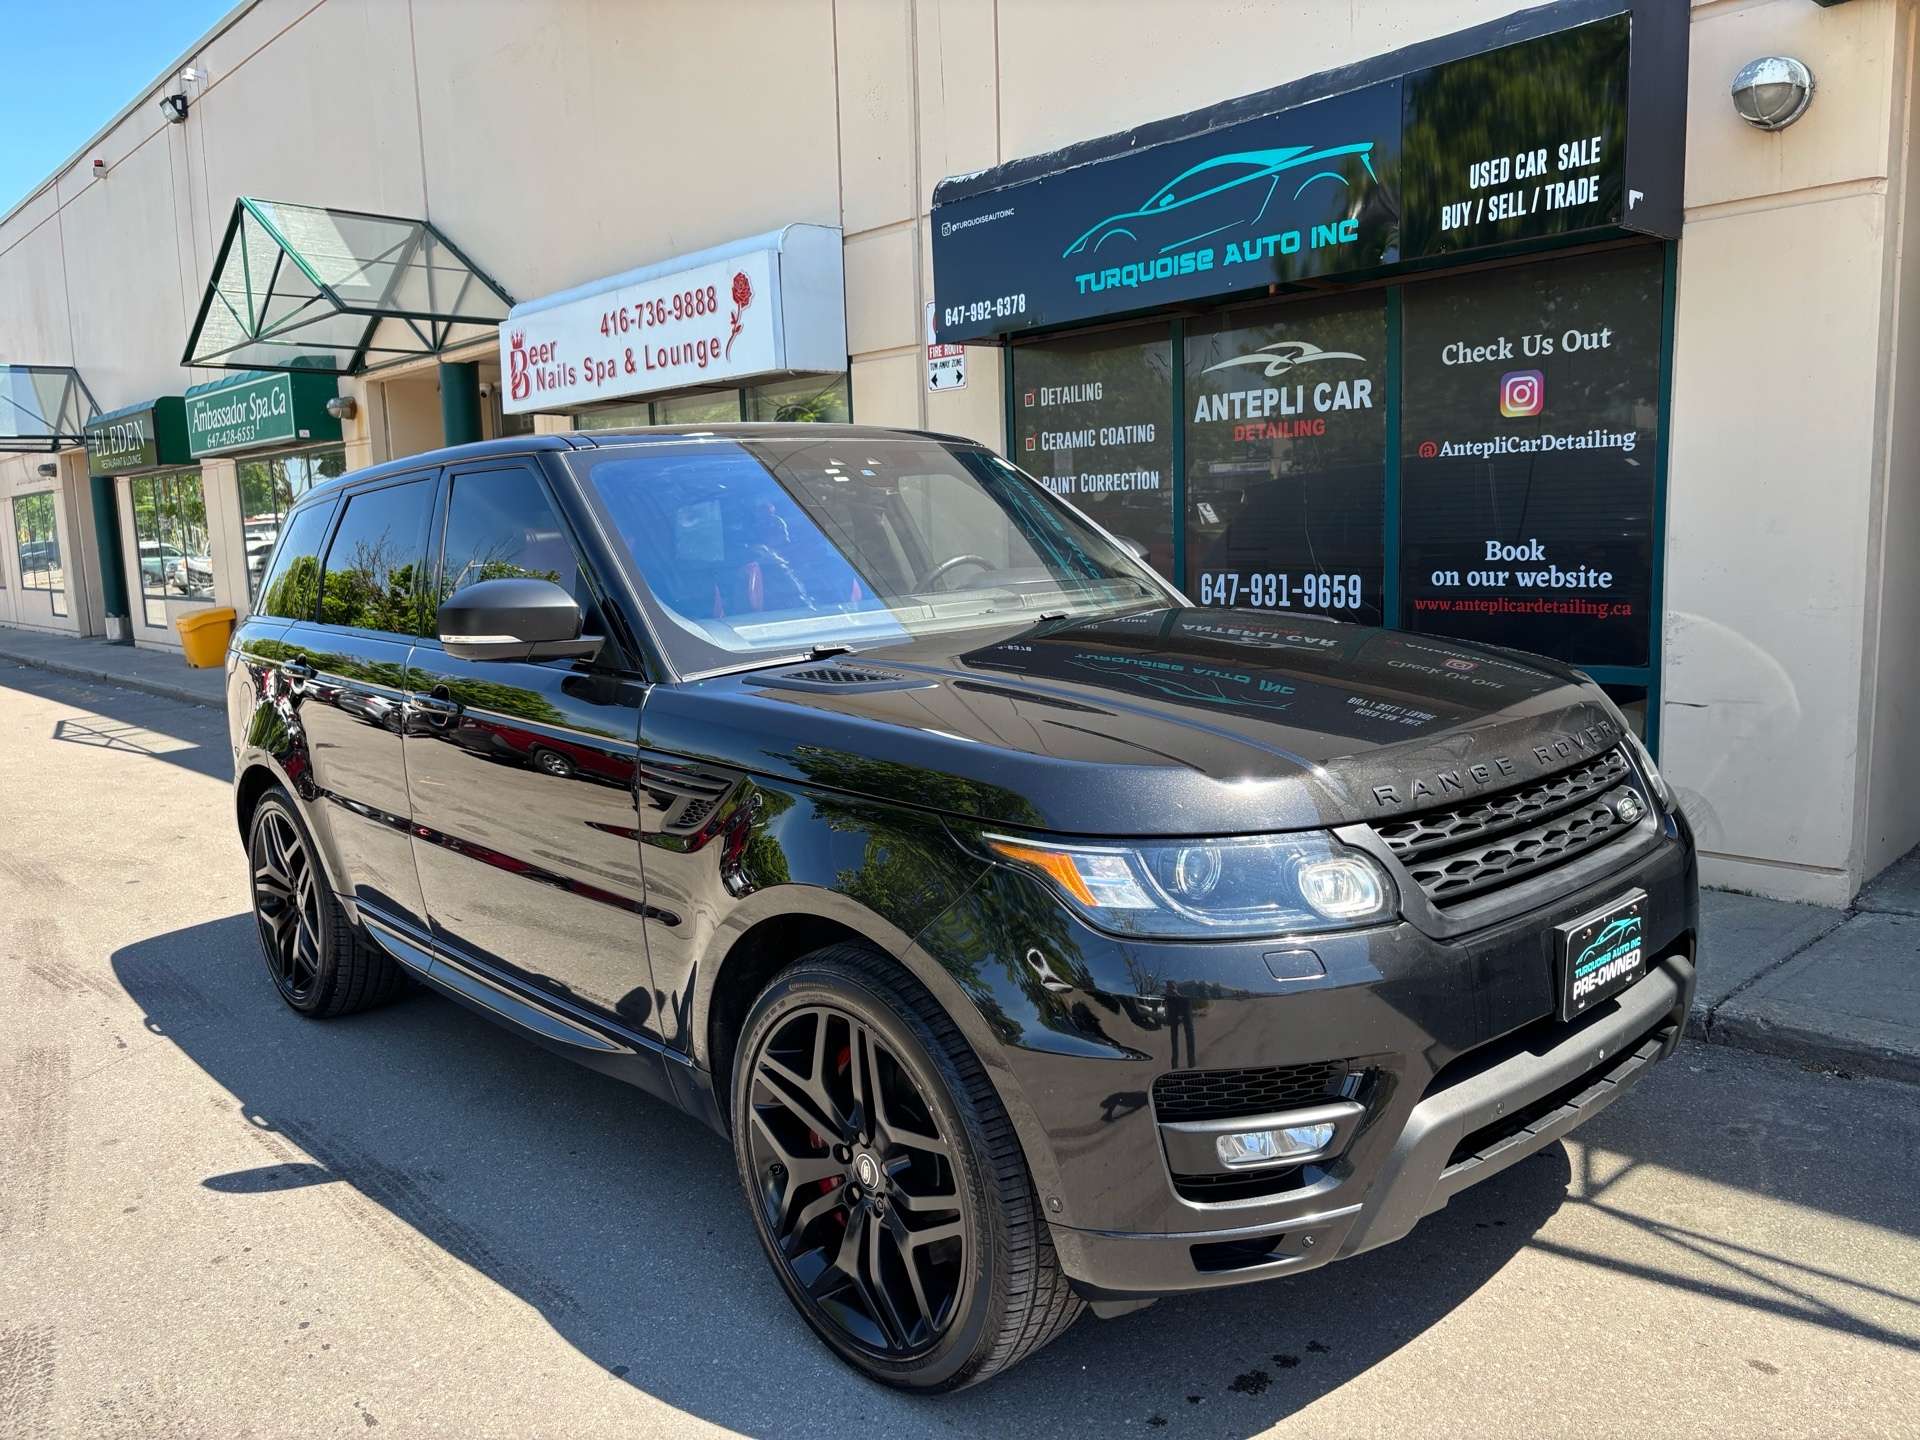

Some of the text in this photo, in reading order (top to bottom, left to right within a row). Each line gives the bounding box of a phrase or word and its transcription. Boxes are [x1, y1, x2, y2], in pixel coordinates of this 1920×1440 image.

[1469, 136, 1601, 190] USED CAR SALE
[1441, 200, 1473, 231] BUY
[1487, 190, 1527, 222] SELL
[1545, 175, 1600, 211] TRADE
[1223, 229, 1301, 266] AUTO
[1310, 218, 1359, 250] INC
[600, 285, 718, 338] 416-736-9888
[945, 293, 1026, 327] 647-992-6378
[535, 335, 721, 392] Nails Spa & Lounge
[929, 345, 943, 359] FIRE
[1442, 327, 1614, 366] Check Us Out
[191, 386, 286, 434] Ambassador Spa.Ca
[1040, 382, 1103, 407] DETAILING
[1194, 378, 1373, 424] ANTEPLI CAR
[94, 419, 145, 457] EL EDEN
[207, 425, 255, 449] 647-428-6553
[1041, 423, 1156, 451] CERAMIC COATING
[1233, 418, 1326, 443] DETAILING
[1418, 428, 1637, 460] @AntepliCarDetailing
[1080, 470, 1159, 493] CORRECTION
[1485, 538, 1547, 562] Book
[1200, 572, 1362, 610] 647-931-9659
[1431, 564, 1613, 589] on our website
[1414, 597, 1633, 619] www.anteplicardetailing.ca
[1372, 721, 1618, 806] RANGE ROVER
[1612, 942, 1630, 959] AUTO
[1630, 936, 1641, 949] INC
[1572, 948, 1641, 1001] PRE-OWNED
